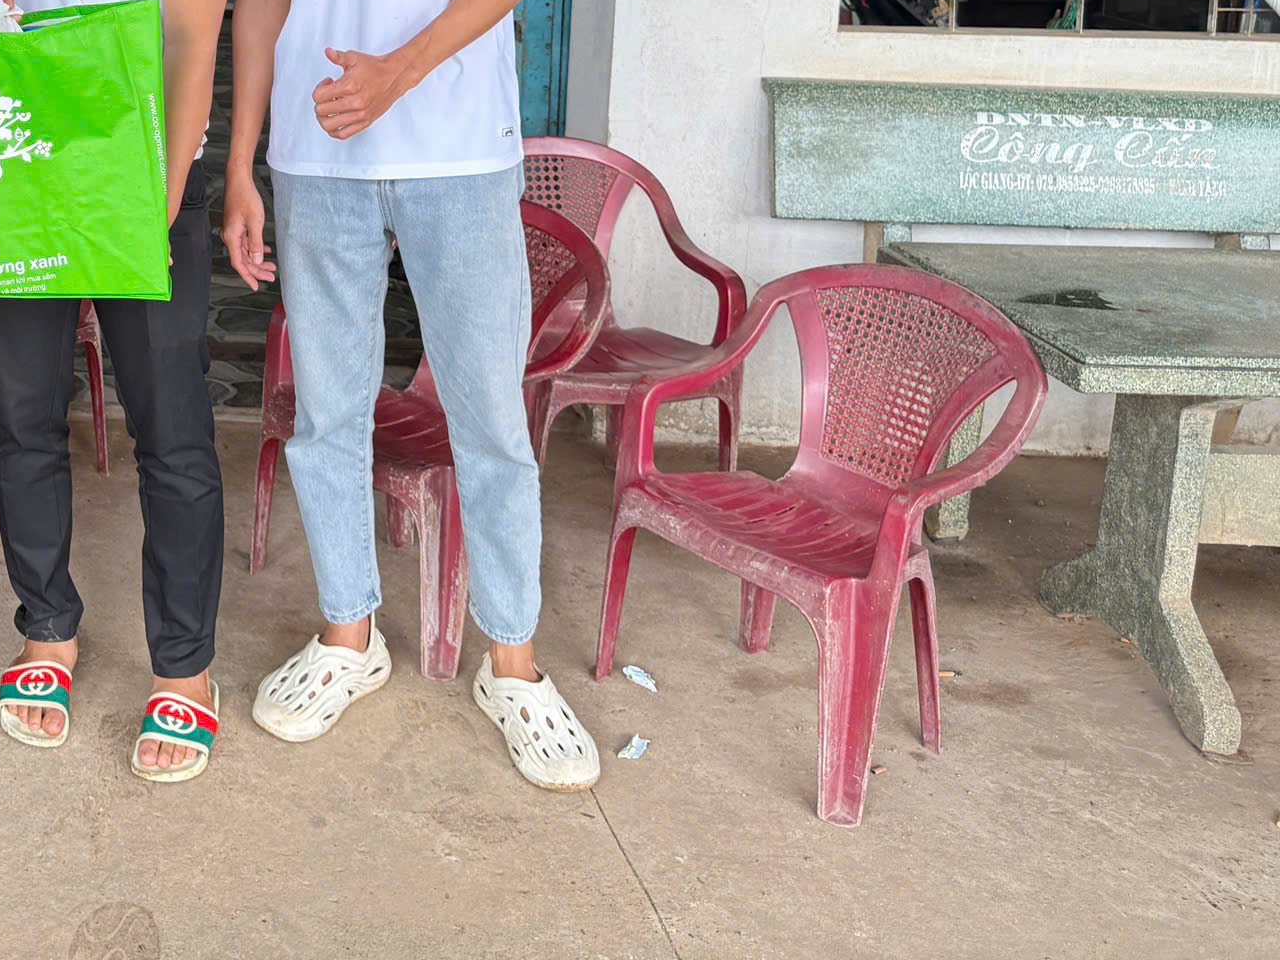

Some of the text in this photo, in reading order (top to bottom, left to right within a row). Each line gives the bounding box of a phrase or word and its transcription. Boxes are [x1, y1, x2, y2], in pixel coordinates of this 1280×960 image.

[960, 126, 1100, 172] Công
[959, 168, 979, 194] LỘC
[30, 253, 68, 270] xanh
